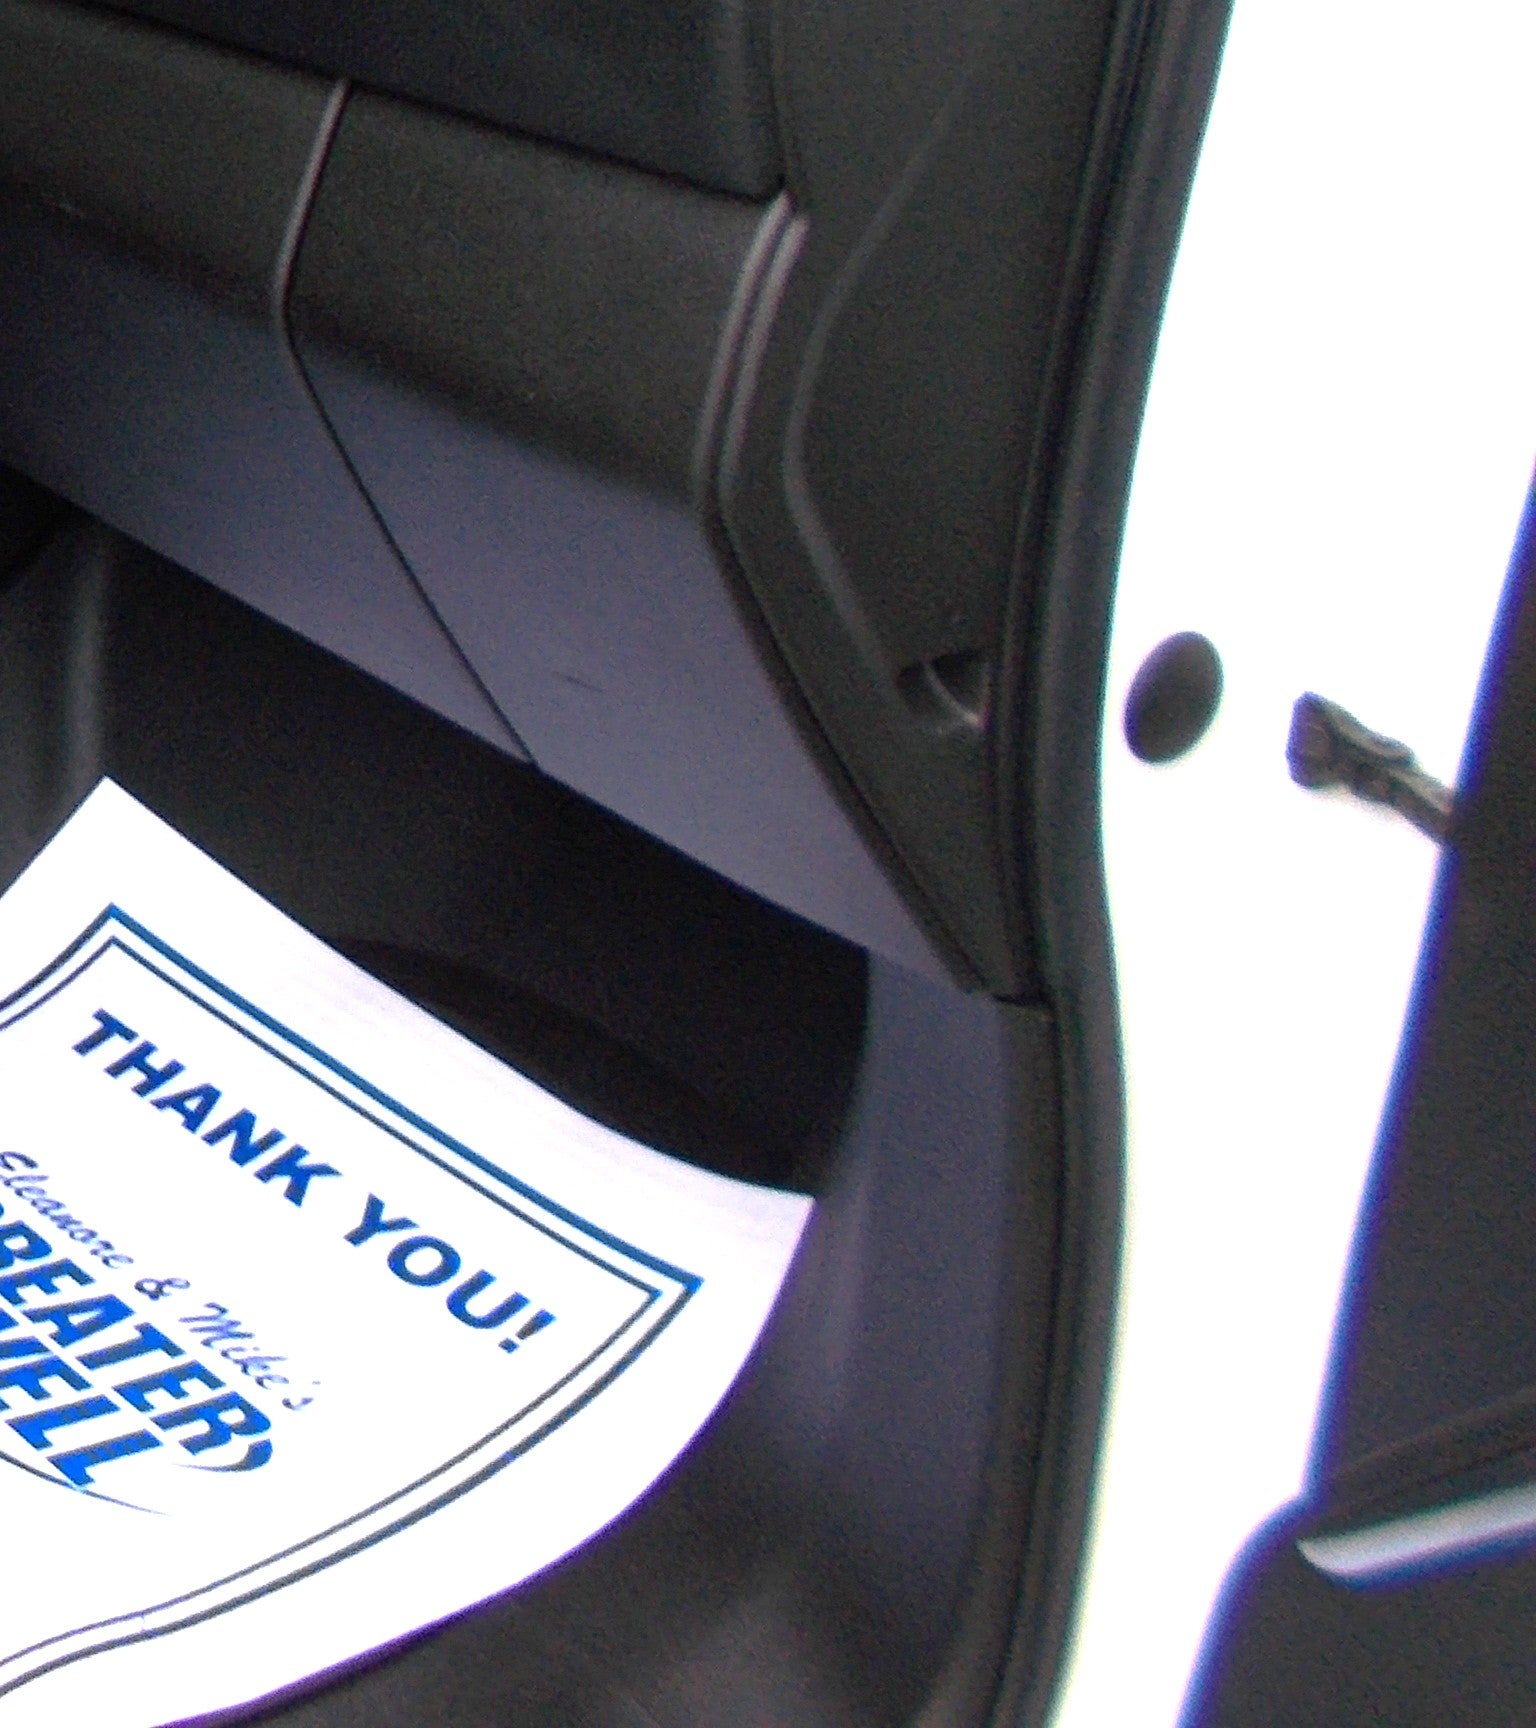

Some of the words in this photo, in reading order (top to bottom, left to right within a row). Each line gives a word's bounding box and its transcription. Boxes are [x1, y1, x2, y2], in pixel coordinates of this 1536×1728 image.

[70, 1007, 343, 1207] THANK
[343, 1192, 557, 1355] YOU!
[134, 1277, 191, 1301] &
[178, 1302, 322, 1411] Mike's
